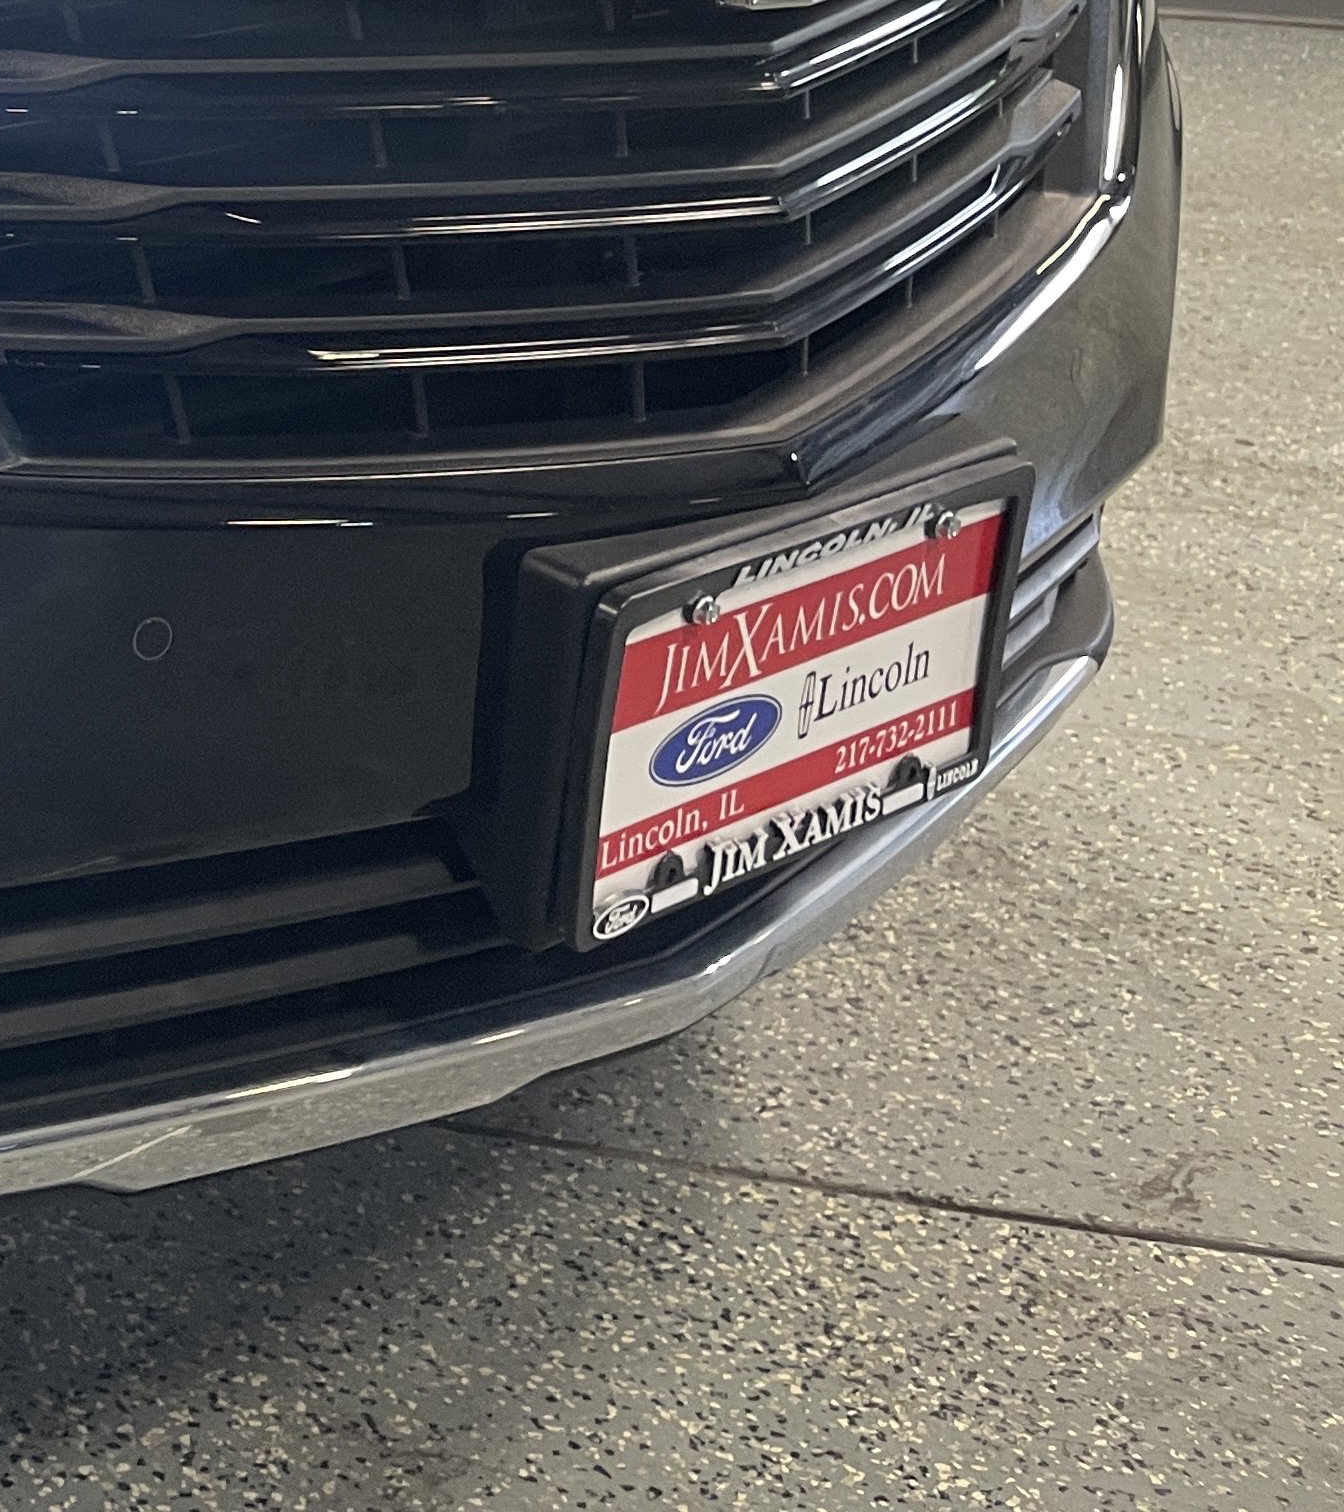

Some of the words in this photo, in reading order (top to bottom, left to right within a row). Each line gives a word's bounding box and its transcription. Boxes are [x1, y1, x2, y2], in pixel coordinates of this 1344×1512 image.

[814, 641, 930, 722] Lincoln
[675, 708, 758, 775] Ford
[834, 700, 958, 774] 217-732-2111
[600, 803, 709, 871] Lincoln,
[719, 789, 745, 821] IL
[703, 830, 769, 896] JIM
[771, 785, 881, 861] XAMIS
